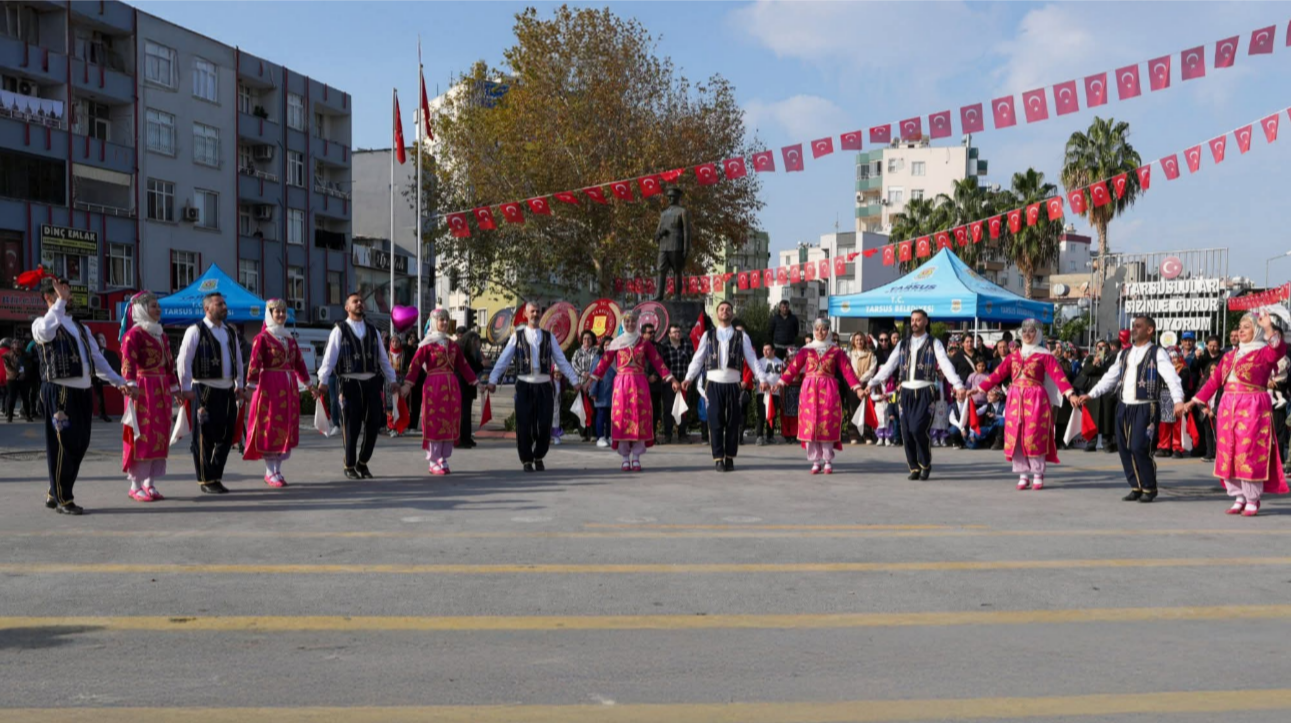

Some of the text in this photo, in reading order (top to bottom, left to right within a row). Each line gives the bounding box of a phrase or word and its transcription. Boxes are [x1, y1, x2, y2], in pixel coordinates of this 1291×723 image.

[43, 226, 96, 241] DİNÇ EMLAK
[1125, 279, 1219, 296] TARSUSLULAR
[164, 308, 193, 316] TARSUS
[866, 305, 893, 314] TARSUS
[1174, 297, 1219, 312] GURUR
